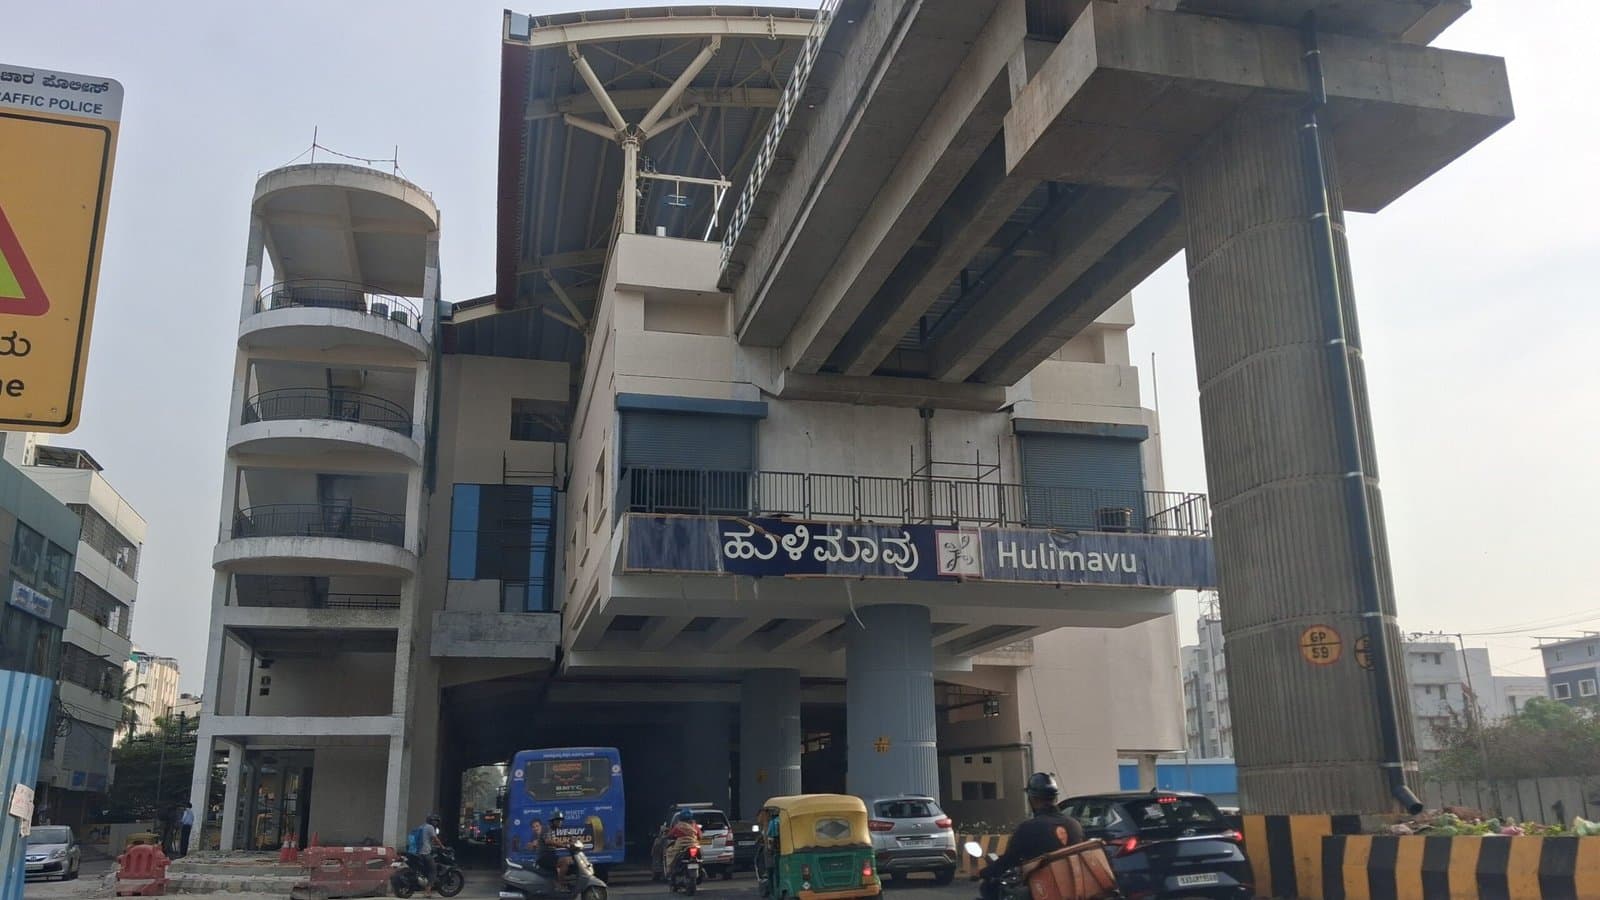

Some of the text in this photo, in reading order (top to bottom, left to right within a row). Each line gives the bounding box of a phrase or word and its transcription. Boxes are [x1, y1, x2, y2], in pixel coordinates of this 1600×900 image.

[0, 91, 103, 114] AFFIC POLICE
[723, 524, 919, 573] ಹುಳಿಮಾವು
[997, 540, 1137, 573] Hulimavu
[1310, 632, 1327, 642] GP
[1311, 646, 1329, 659] 59
